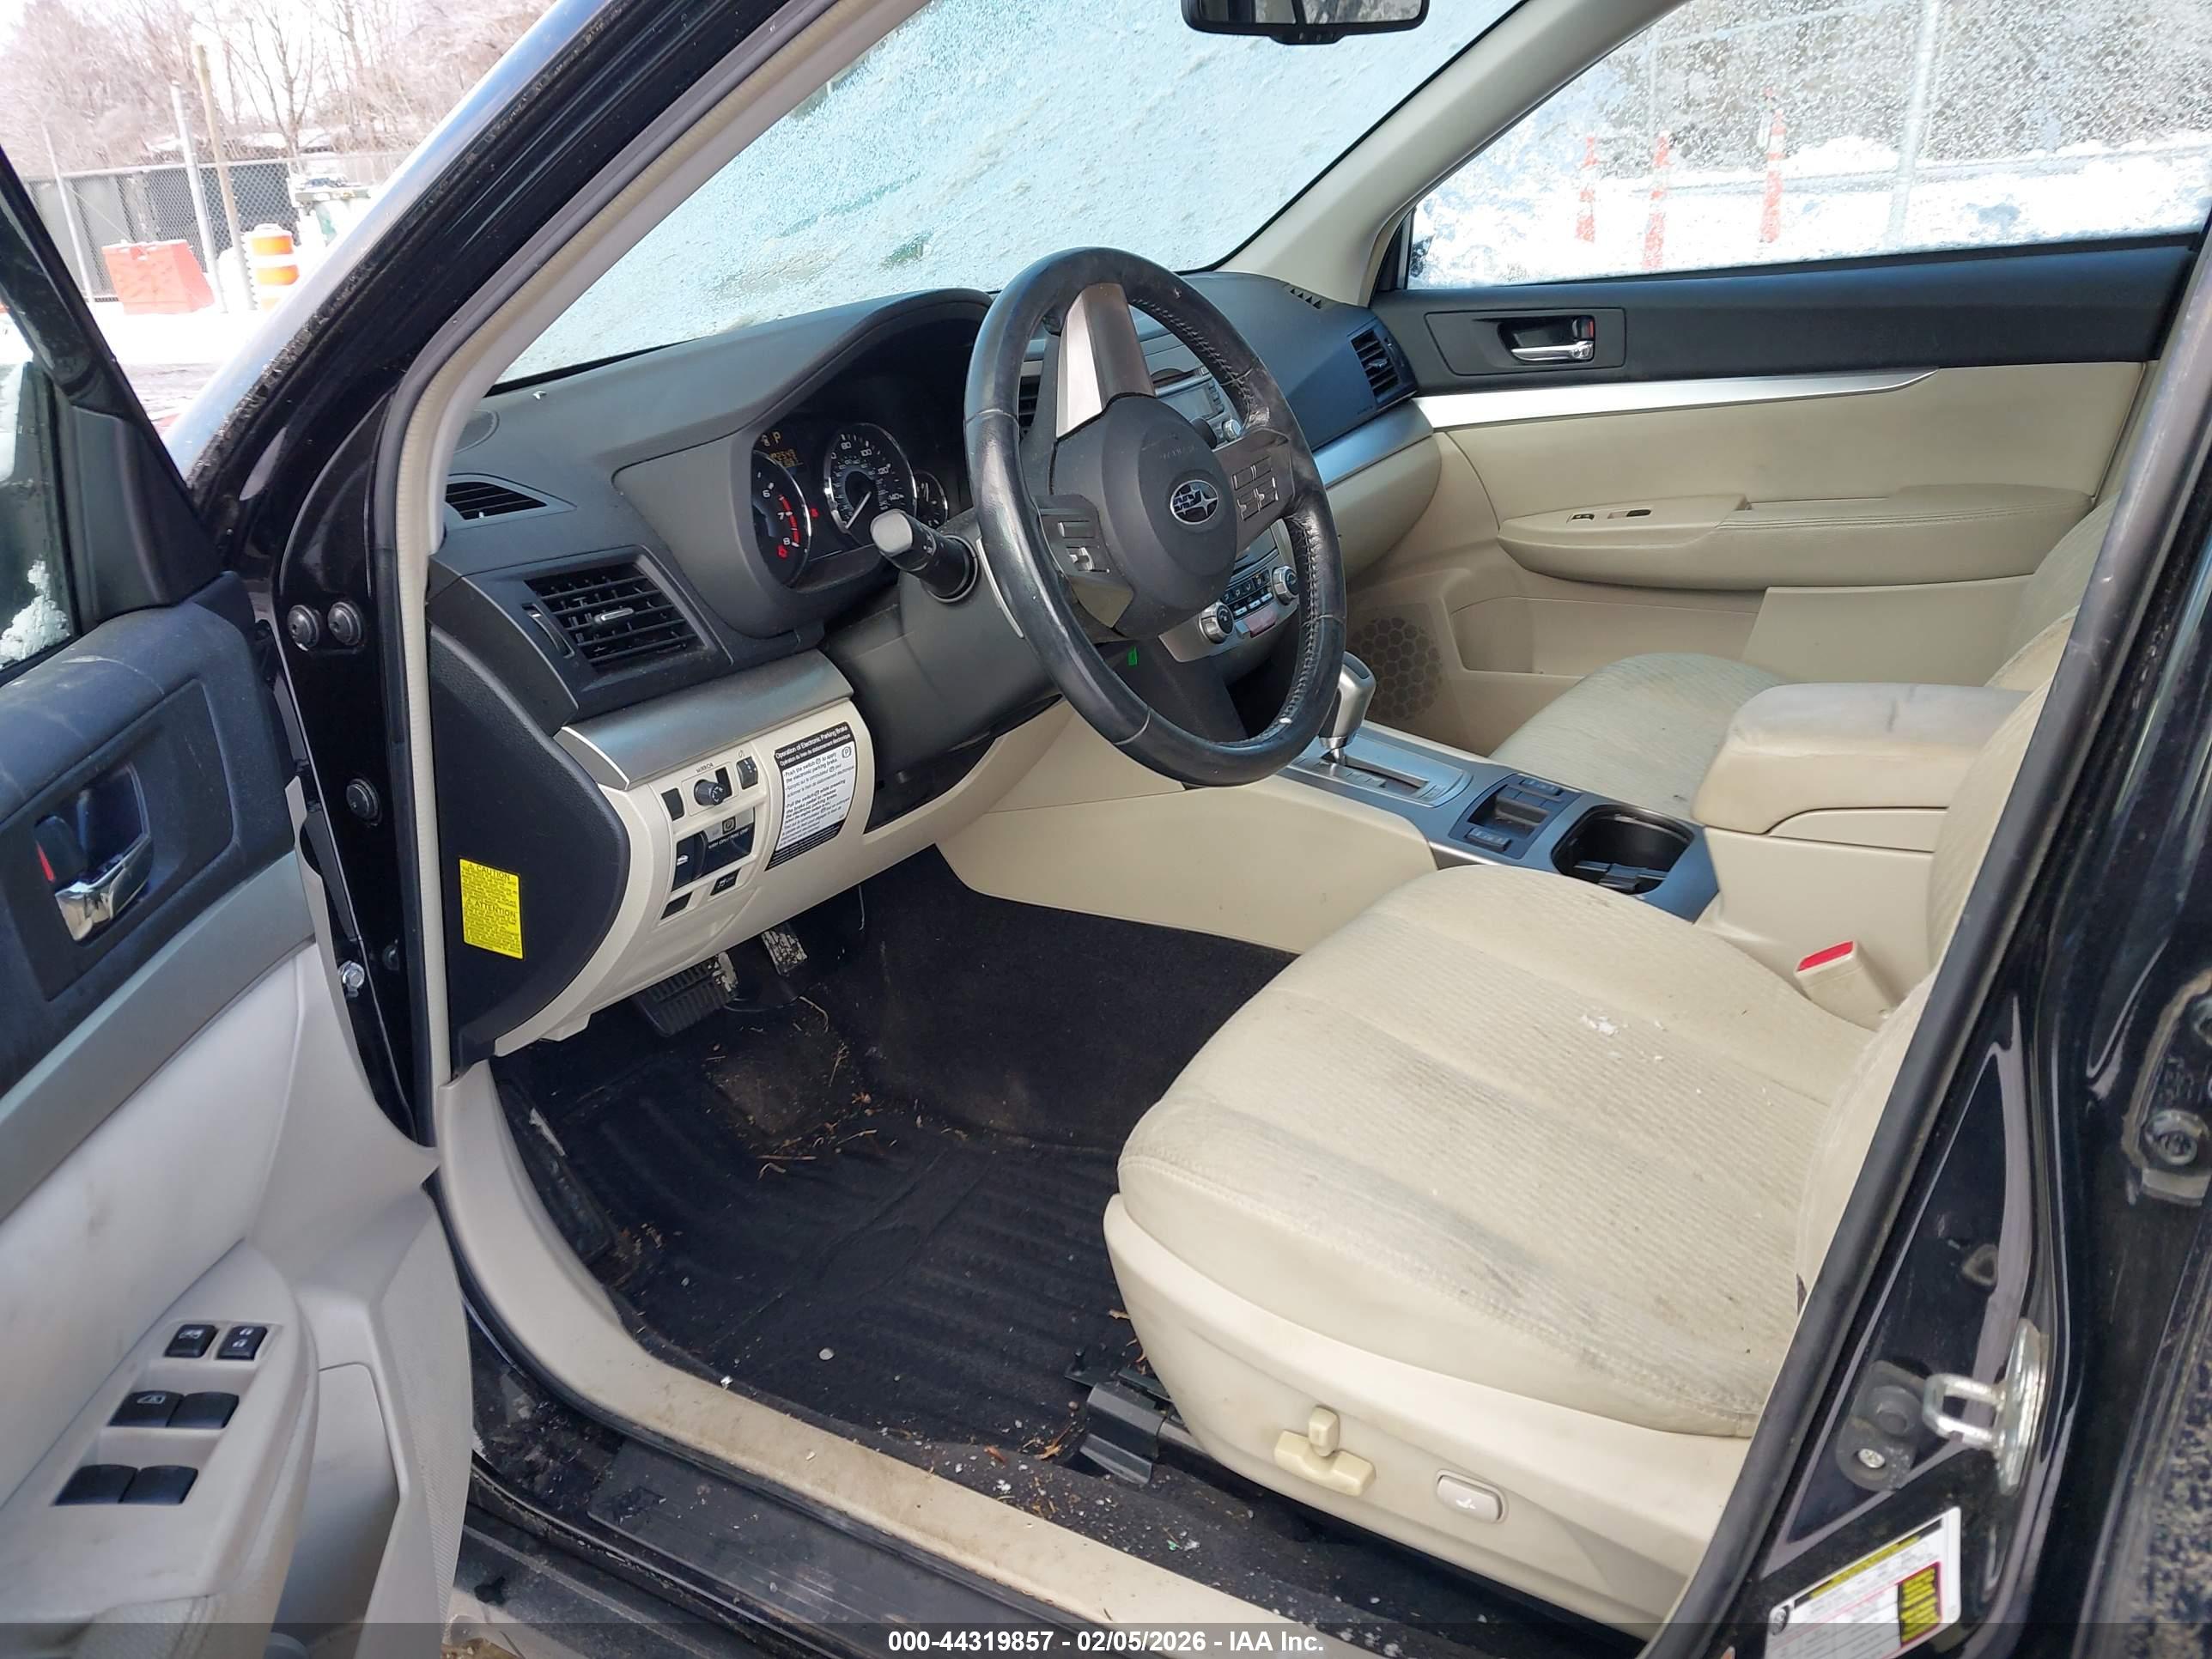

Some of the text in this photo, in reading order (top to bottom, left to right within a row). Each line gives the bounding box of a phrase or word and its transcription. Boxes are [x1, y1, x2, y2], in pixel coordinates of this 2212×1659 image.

[763, 489, 770, 498] 6
[777, 512, 785, 520] 7
[782, 537, 791, 545] 8
[775, 747, 797, 759] Operation
[801, 737, 821, 748] Electronic
[821, 731, 836, 741] Parking
[836, 726, 848, 734] Brake
[696, 762, 714, 773] MIRROR
[477, 864, 511, 881] CAUTION
[475, 900, 517, 919] ATTENTION
